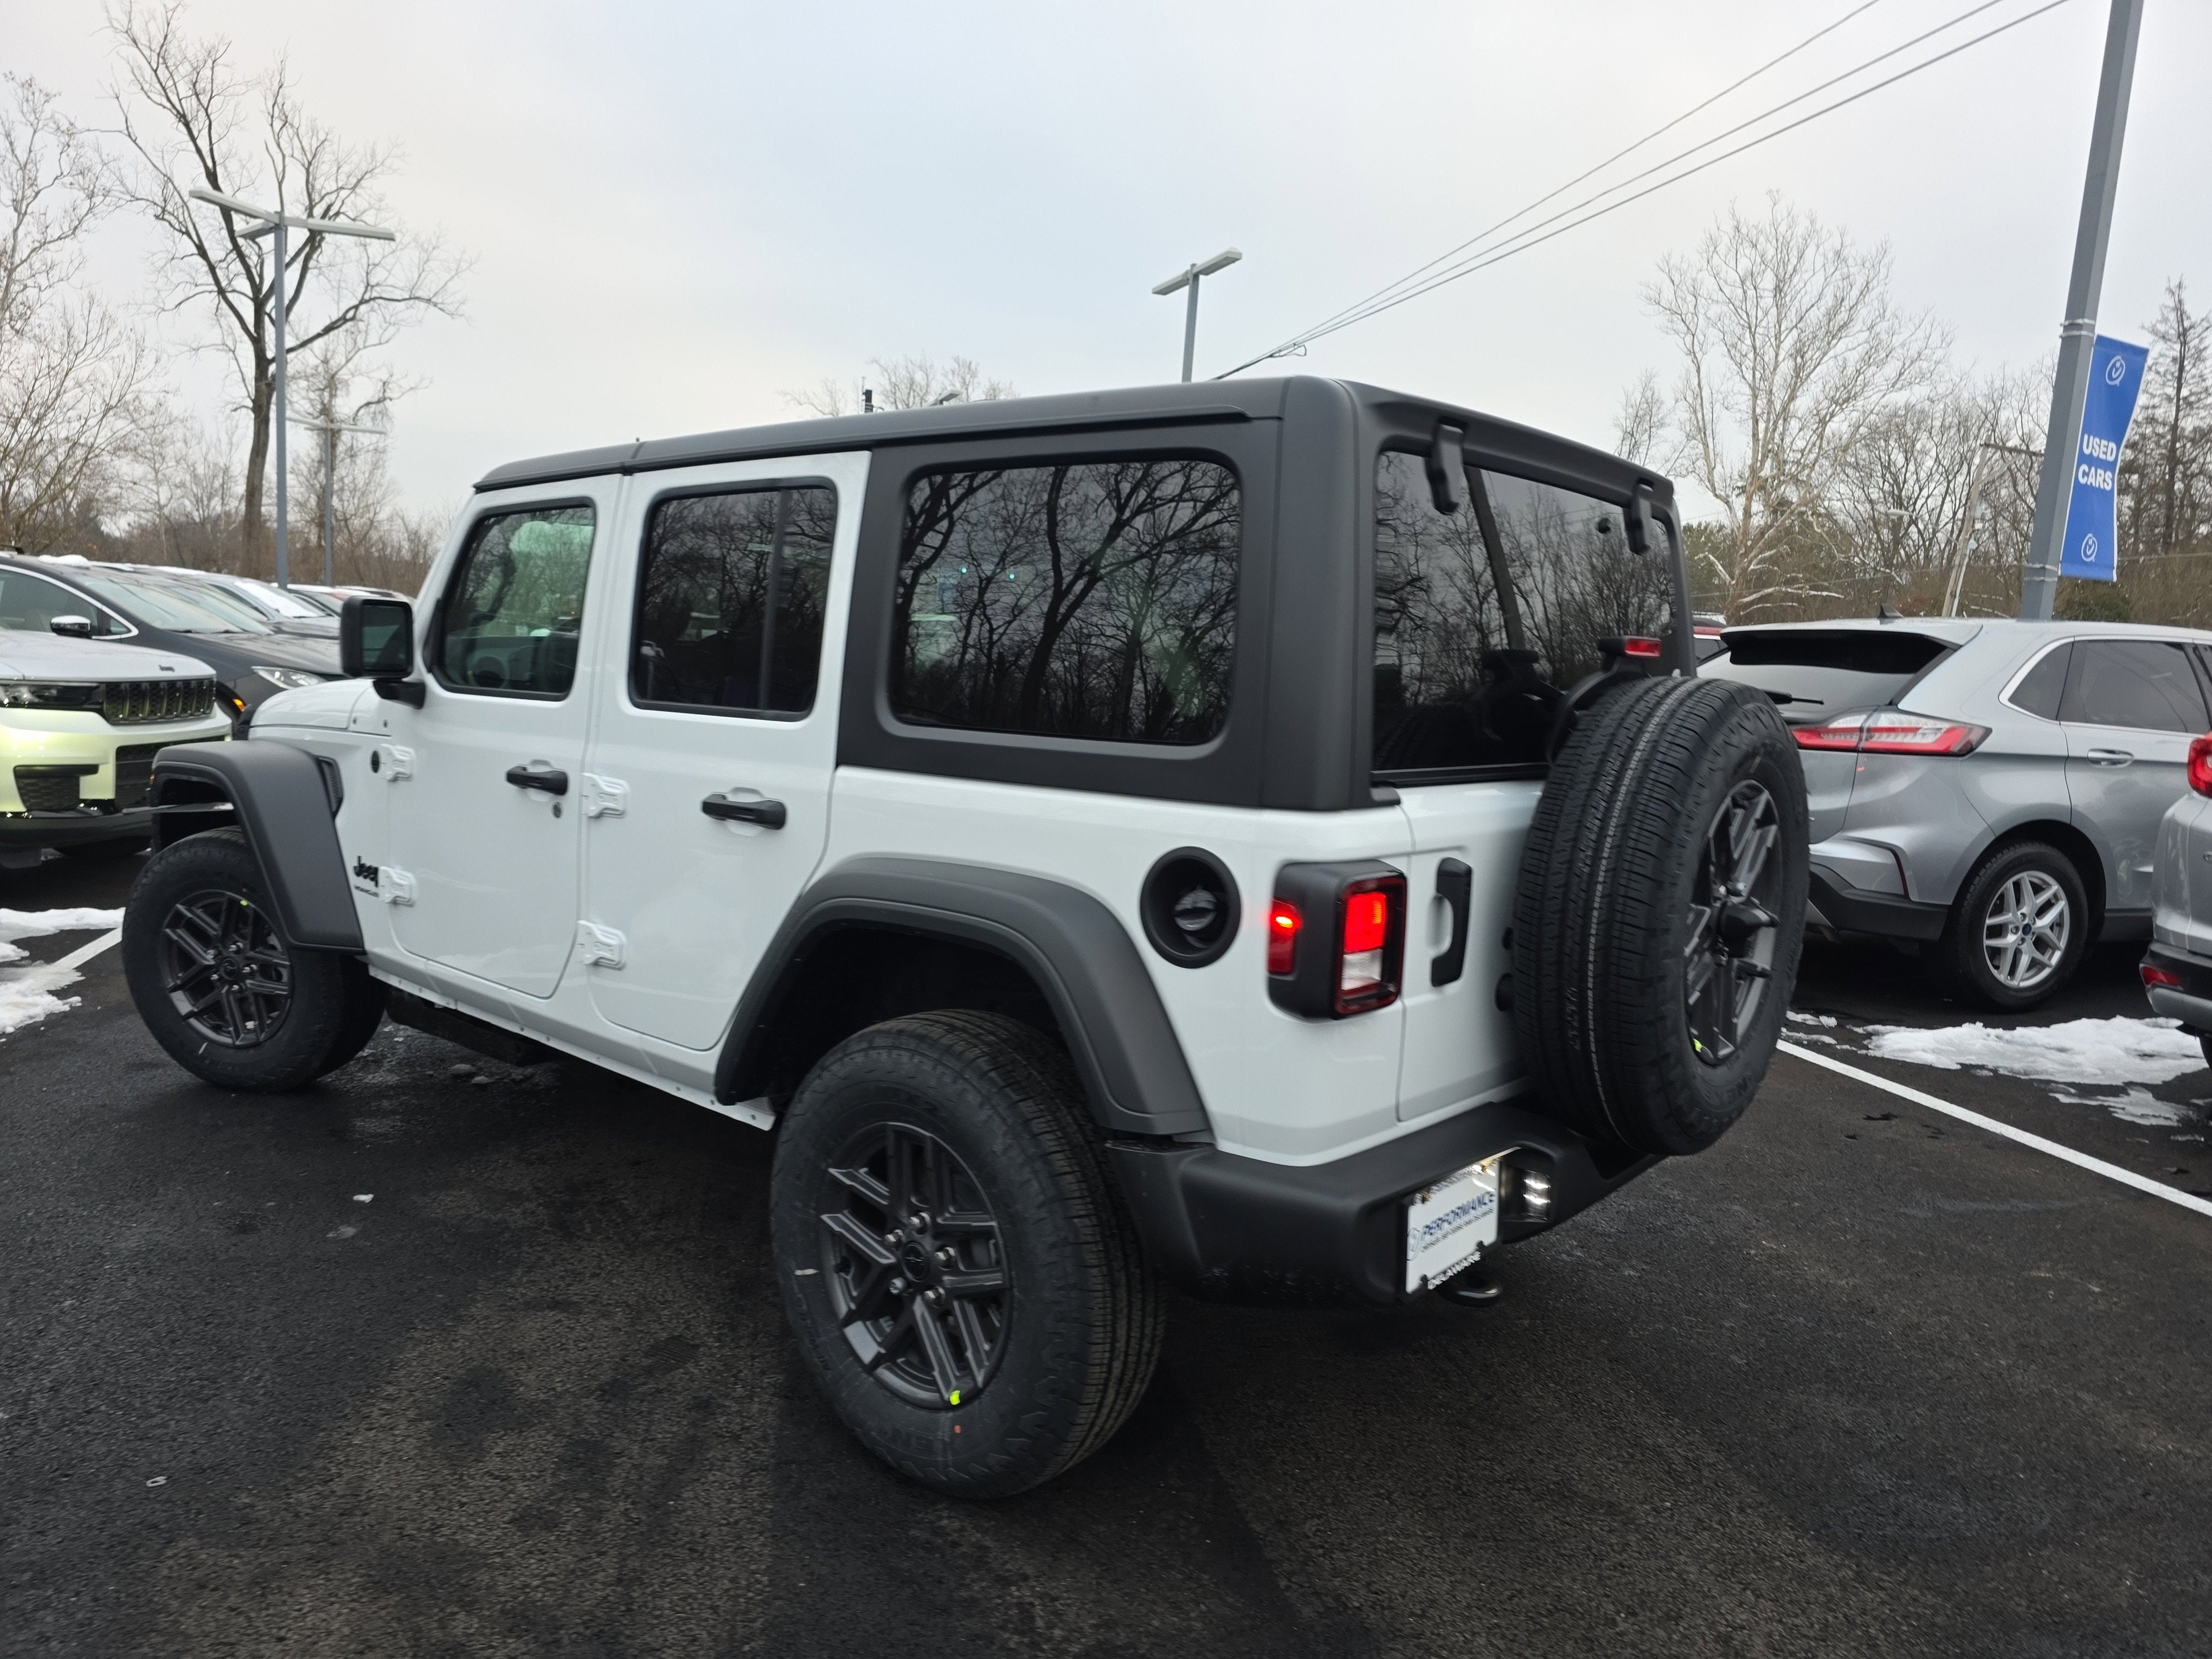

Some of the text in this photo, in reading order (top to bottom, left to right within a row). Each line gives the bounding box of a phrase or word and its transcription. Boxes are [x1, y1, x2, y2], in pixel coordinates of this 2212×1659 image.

[2083, 434, 2117, 462] USED
[2078, 464, 2112, 491] CARS
[353, 856, 378, 887] Jeep
[1422, 1192, 1495, 1240] PERFORMANCE
